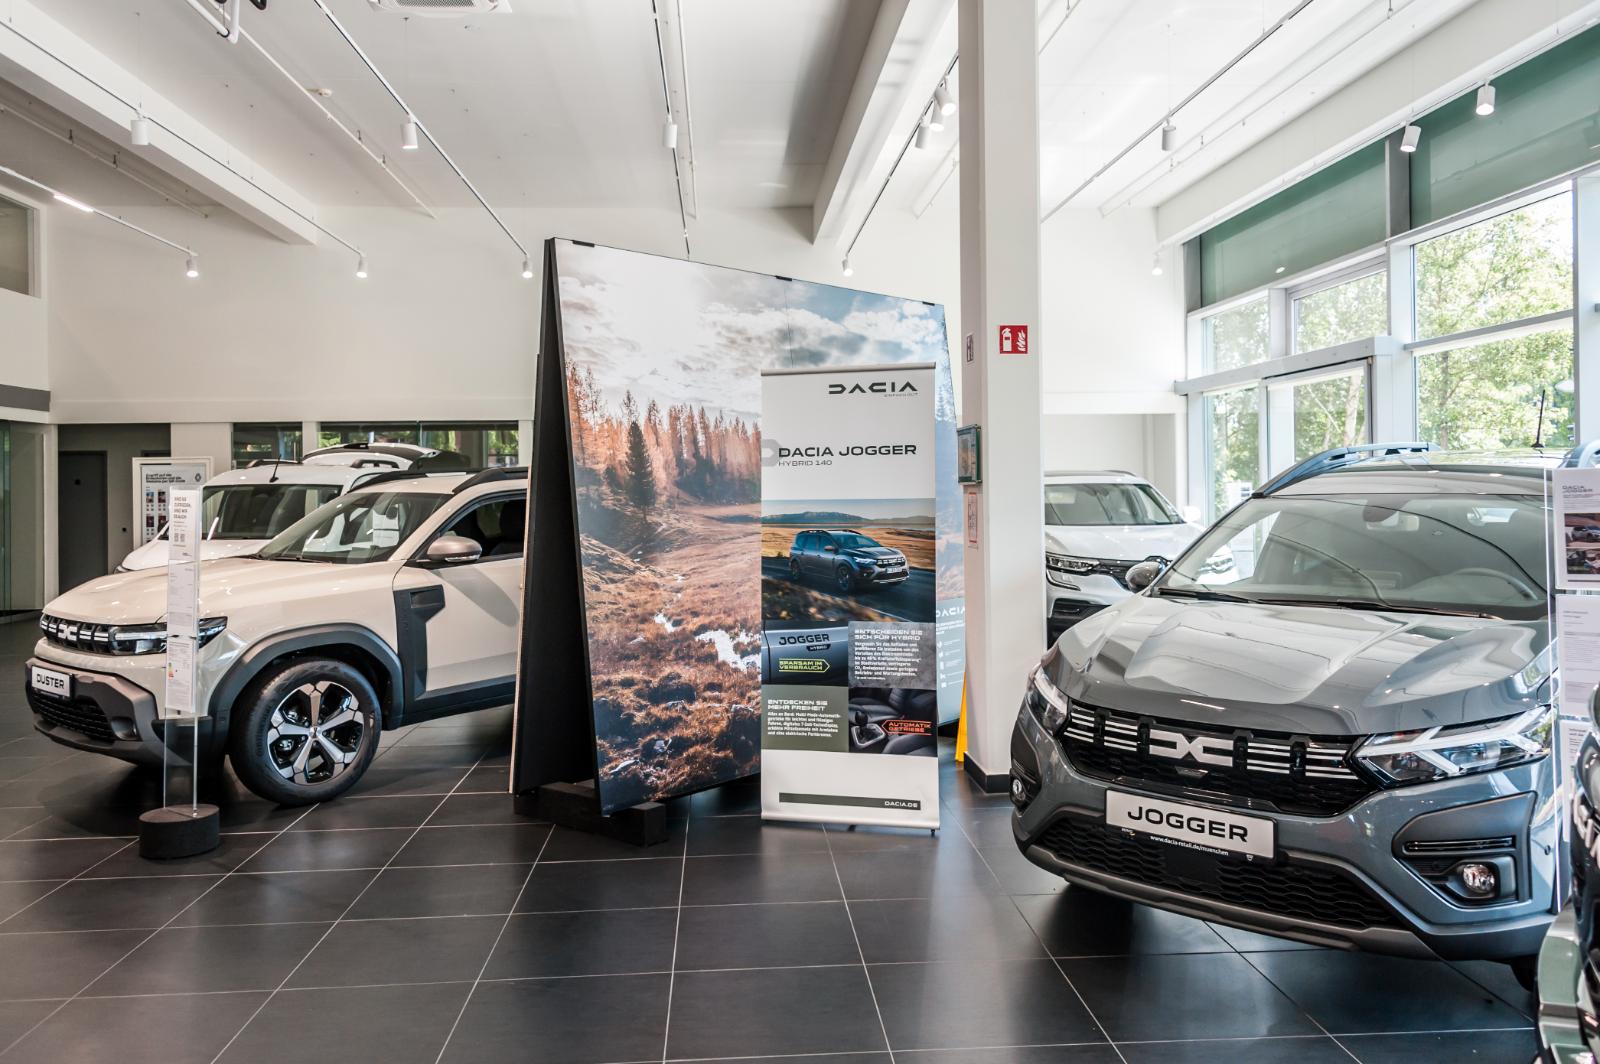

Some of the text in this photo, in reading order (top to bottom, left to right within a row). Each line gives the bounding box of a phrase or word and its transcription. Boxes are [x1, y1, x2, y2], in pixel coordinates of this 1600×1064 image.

[829, 381, 918, 394] DACIA
[779, 445, 916, 457] DACIA JOGGER
[779, 634, 829, 645] JOGGER
[37, 674, 64, 689] DUSTER
[1128, 806, 1248, 842] JOGGER
